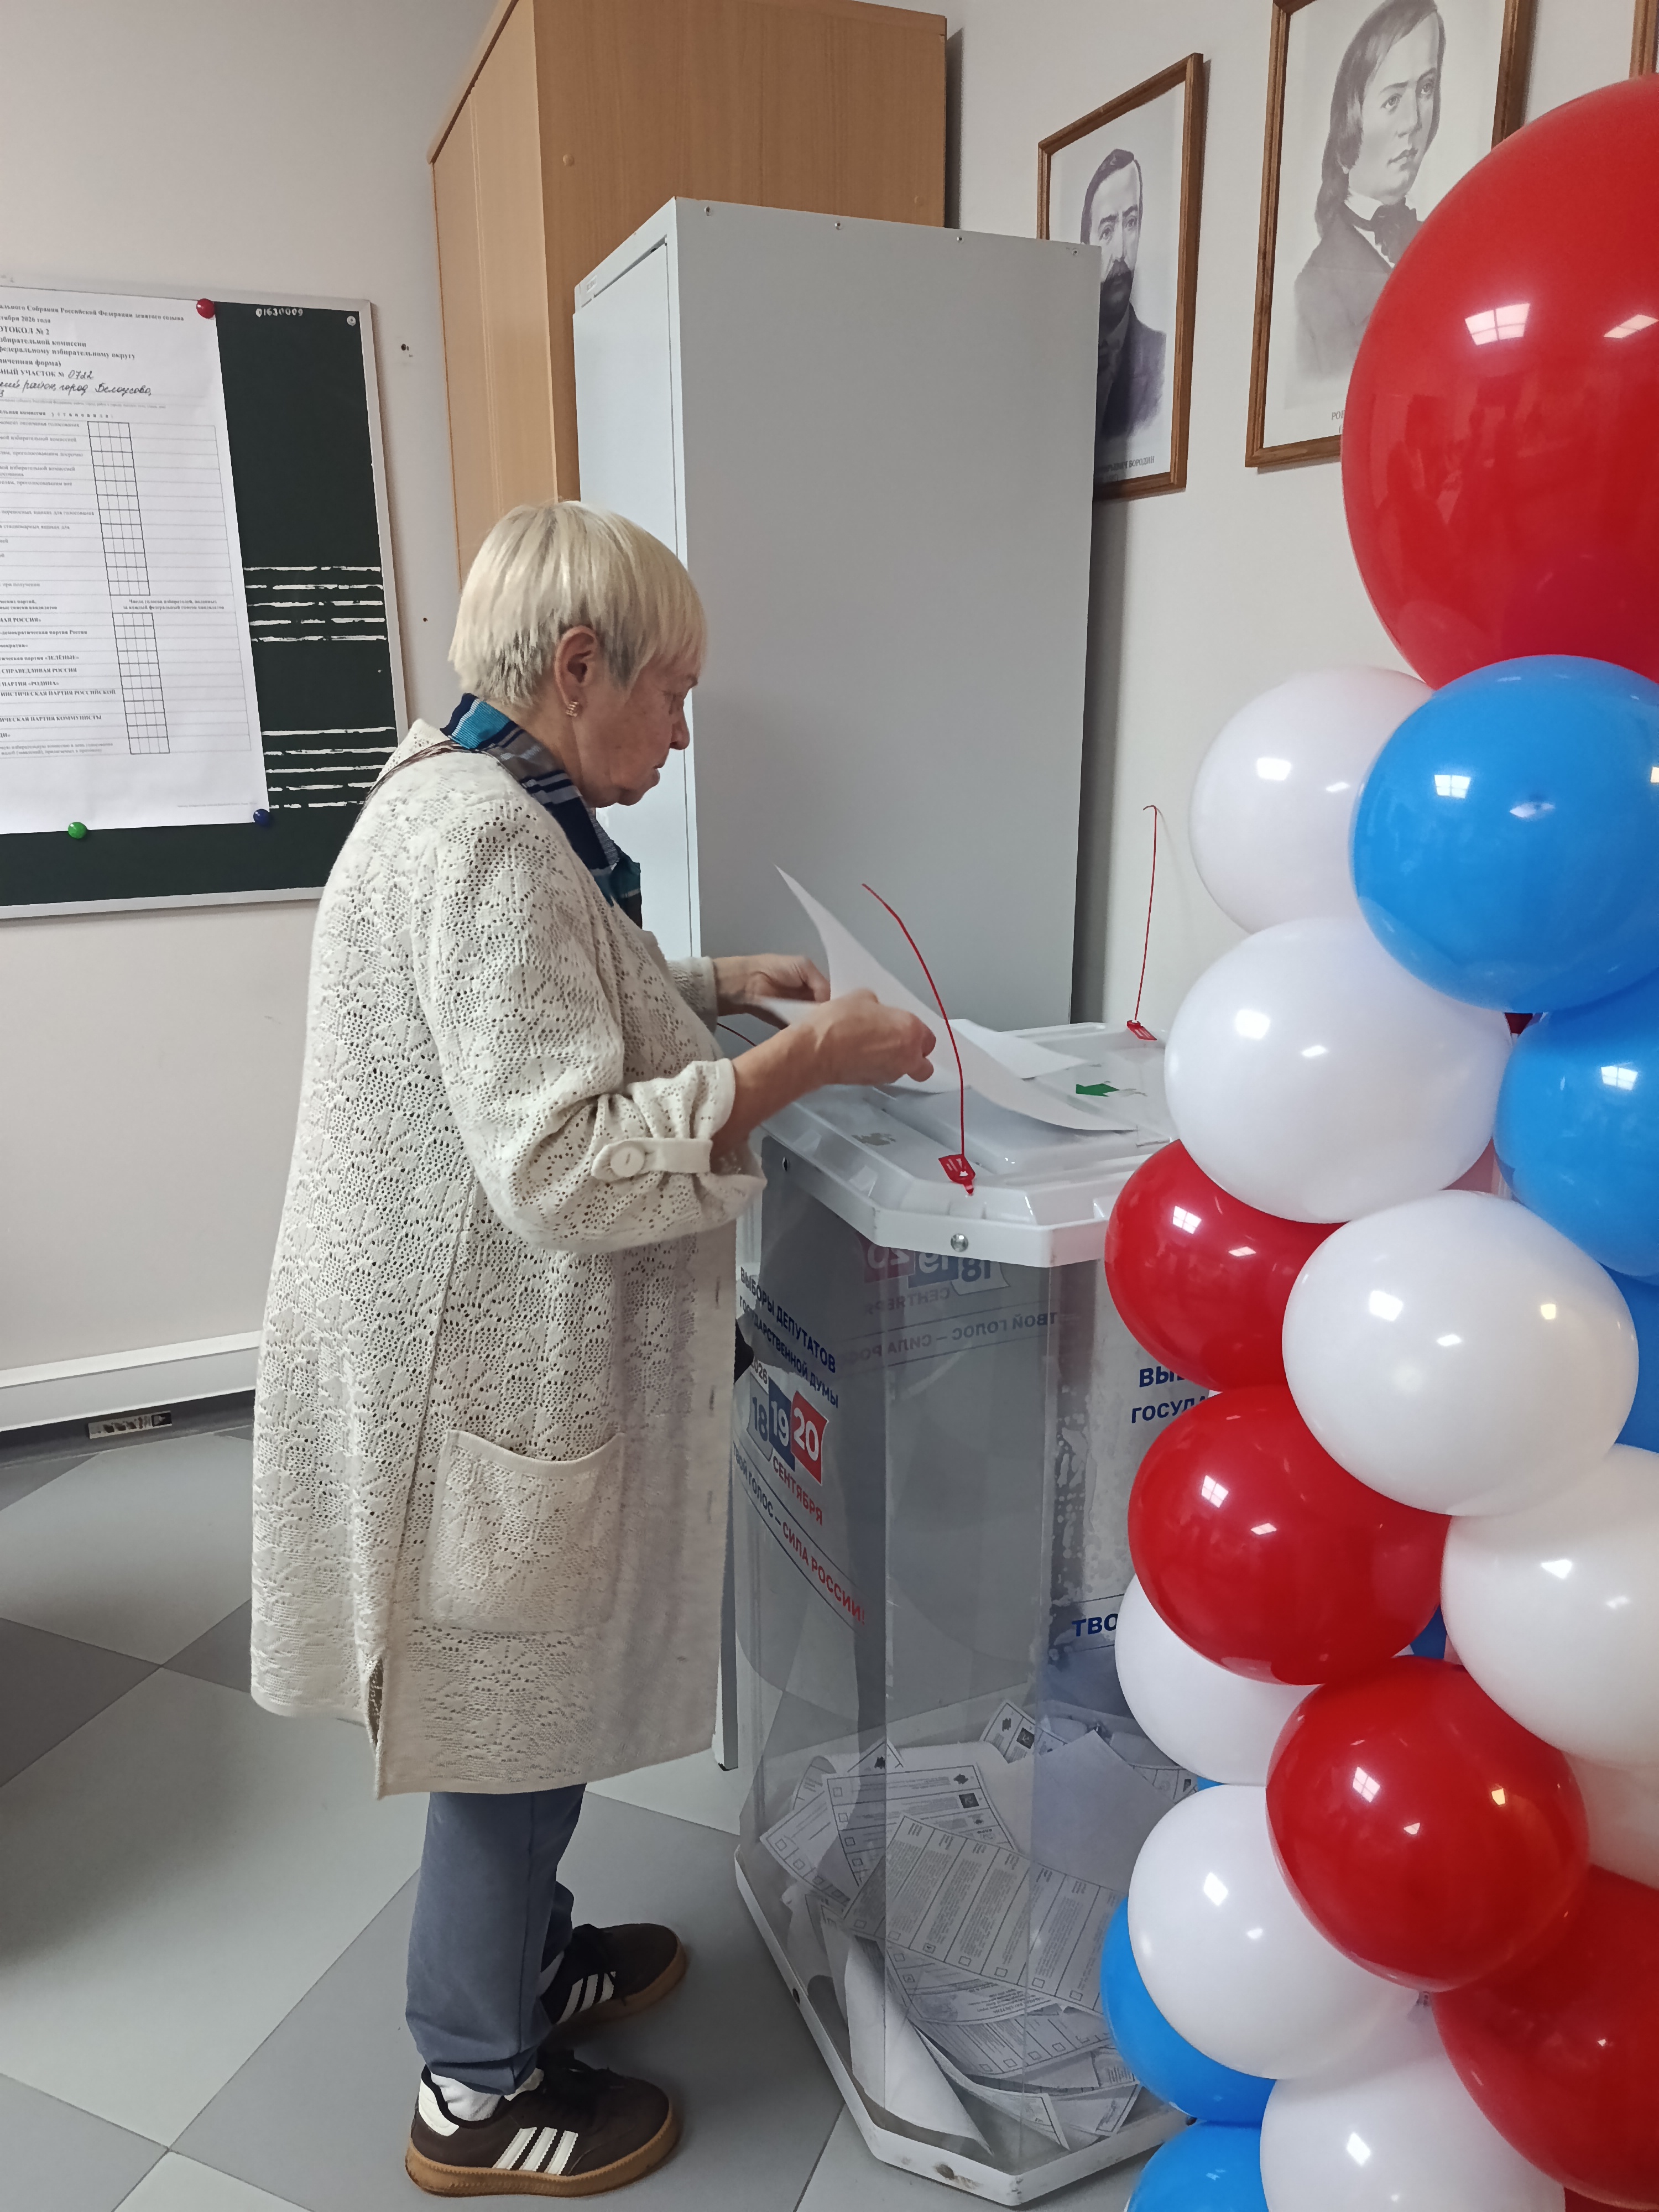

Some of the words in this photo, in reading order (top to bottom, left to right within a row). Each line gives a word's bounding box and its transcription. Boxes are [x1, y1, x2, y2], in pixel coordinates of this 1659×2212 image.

[98, 310, 133, 318] Федерации
[35, 359, 61, 367] форма)
[52, 348, 109, 358] избирательному
[1129, 456, 1155, 468] БОРОДИН
[740, 1266, 774, 1316] ВЫБОРЫ
[776, 1306, 836, 1373] ДЕПУТАТОВ
[810, 1371, 838, 1408] ДУМЫ
[752, 1396, 768, 1442] 18
[771, 1401, 789, 1447] 19
[794, 1407, 819, 1461] 20
[773, 1455, 822, 1526] СЕНТЯБРЯ
[748, 1471, 773, 1518] ГОЛОС
[782, 1522, 808, 1566] СИЛА
[811, 1556, 865, 1625] РОССИИ!
